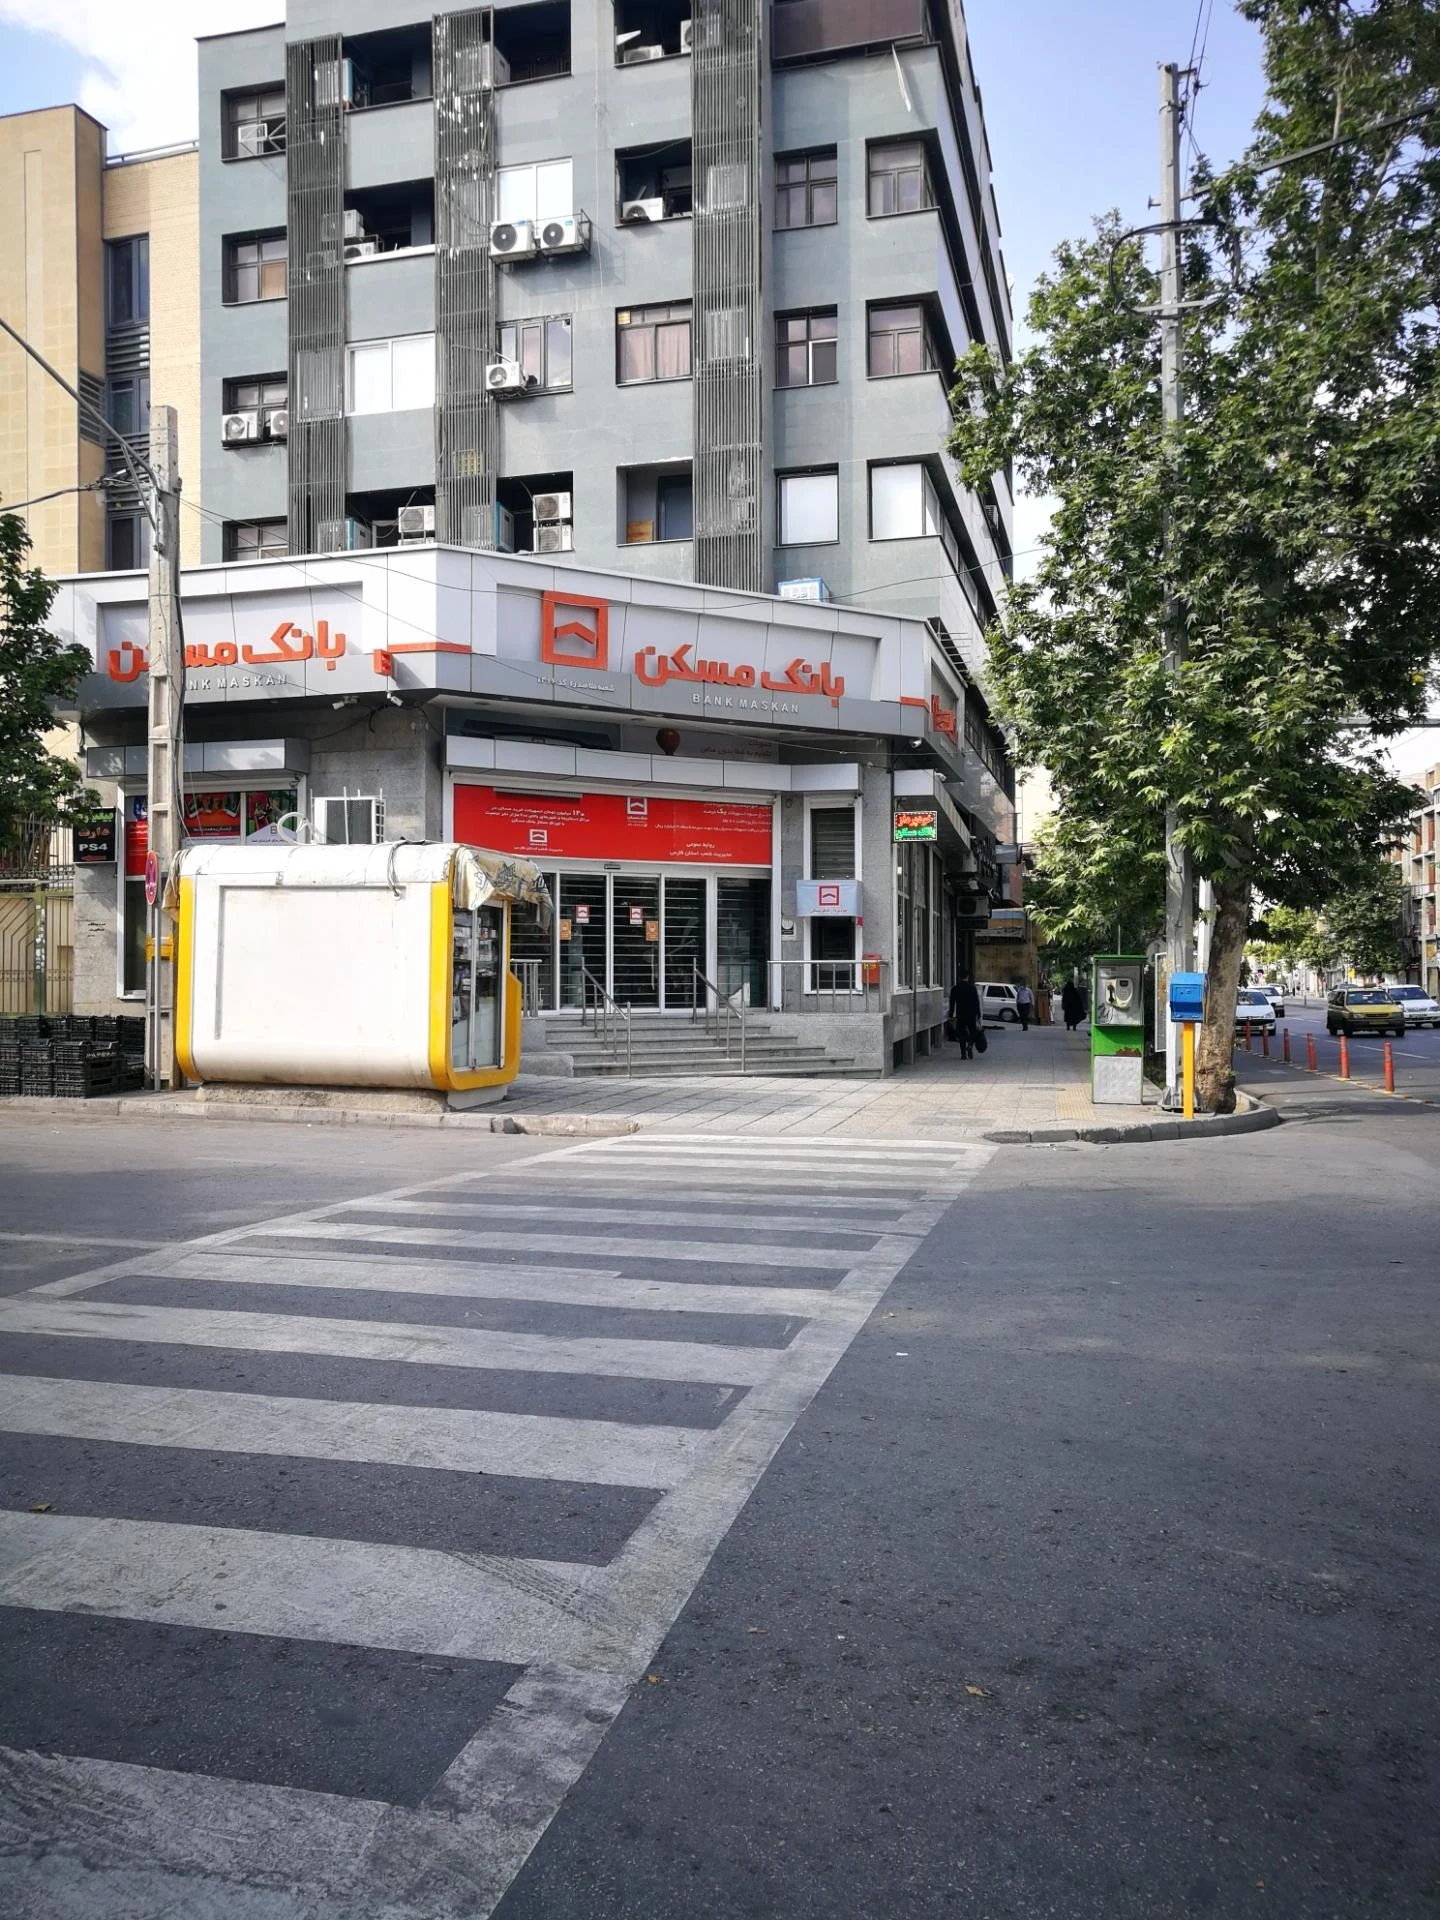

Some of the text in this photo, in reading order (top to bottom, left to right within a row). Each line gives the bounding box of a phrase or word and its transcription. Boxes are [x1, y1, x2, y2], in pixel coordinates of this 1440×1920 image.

[108, 620, 346, 683] بانک مسن
[217, 674, 287, 690] MASKAN
[634, 643, 845, 708] بانک مسکن
[692, 693, 800, 713] BANK MASKAN
[79, 843, 108, 852] PS4
